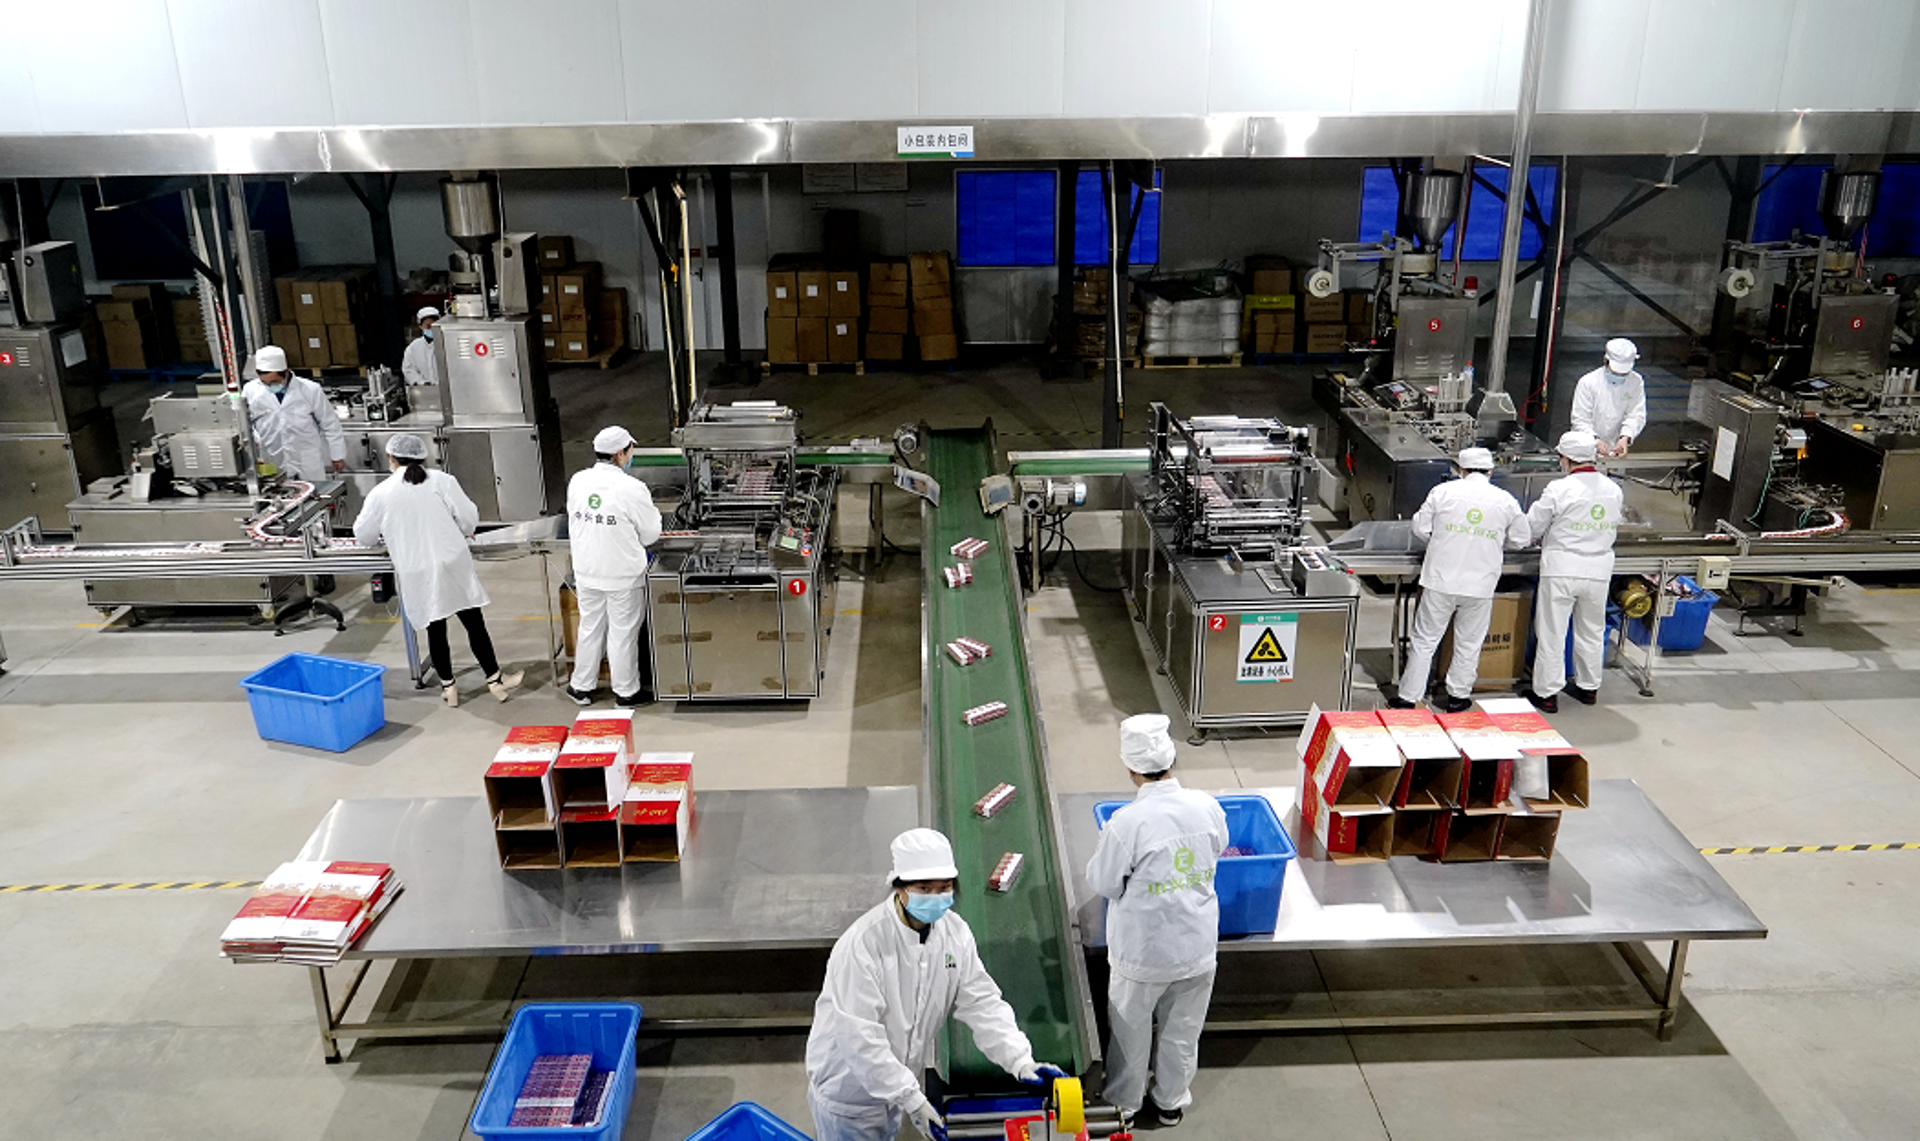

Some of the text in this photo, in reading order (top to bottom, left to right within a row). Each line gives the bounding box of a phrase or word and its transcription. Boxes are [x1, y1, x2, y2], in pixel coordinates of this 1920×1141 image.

[904, 133, 968, 147] 小包装内包间
[1431, 320, 1438, 330] 5
[1853, 319, 1861, 328] 6
[477, 344, 486, 354] 4
[793, 581, 800, 593] 1
[1213, 617, 1223, 629] 2
